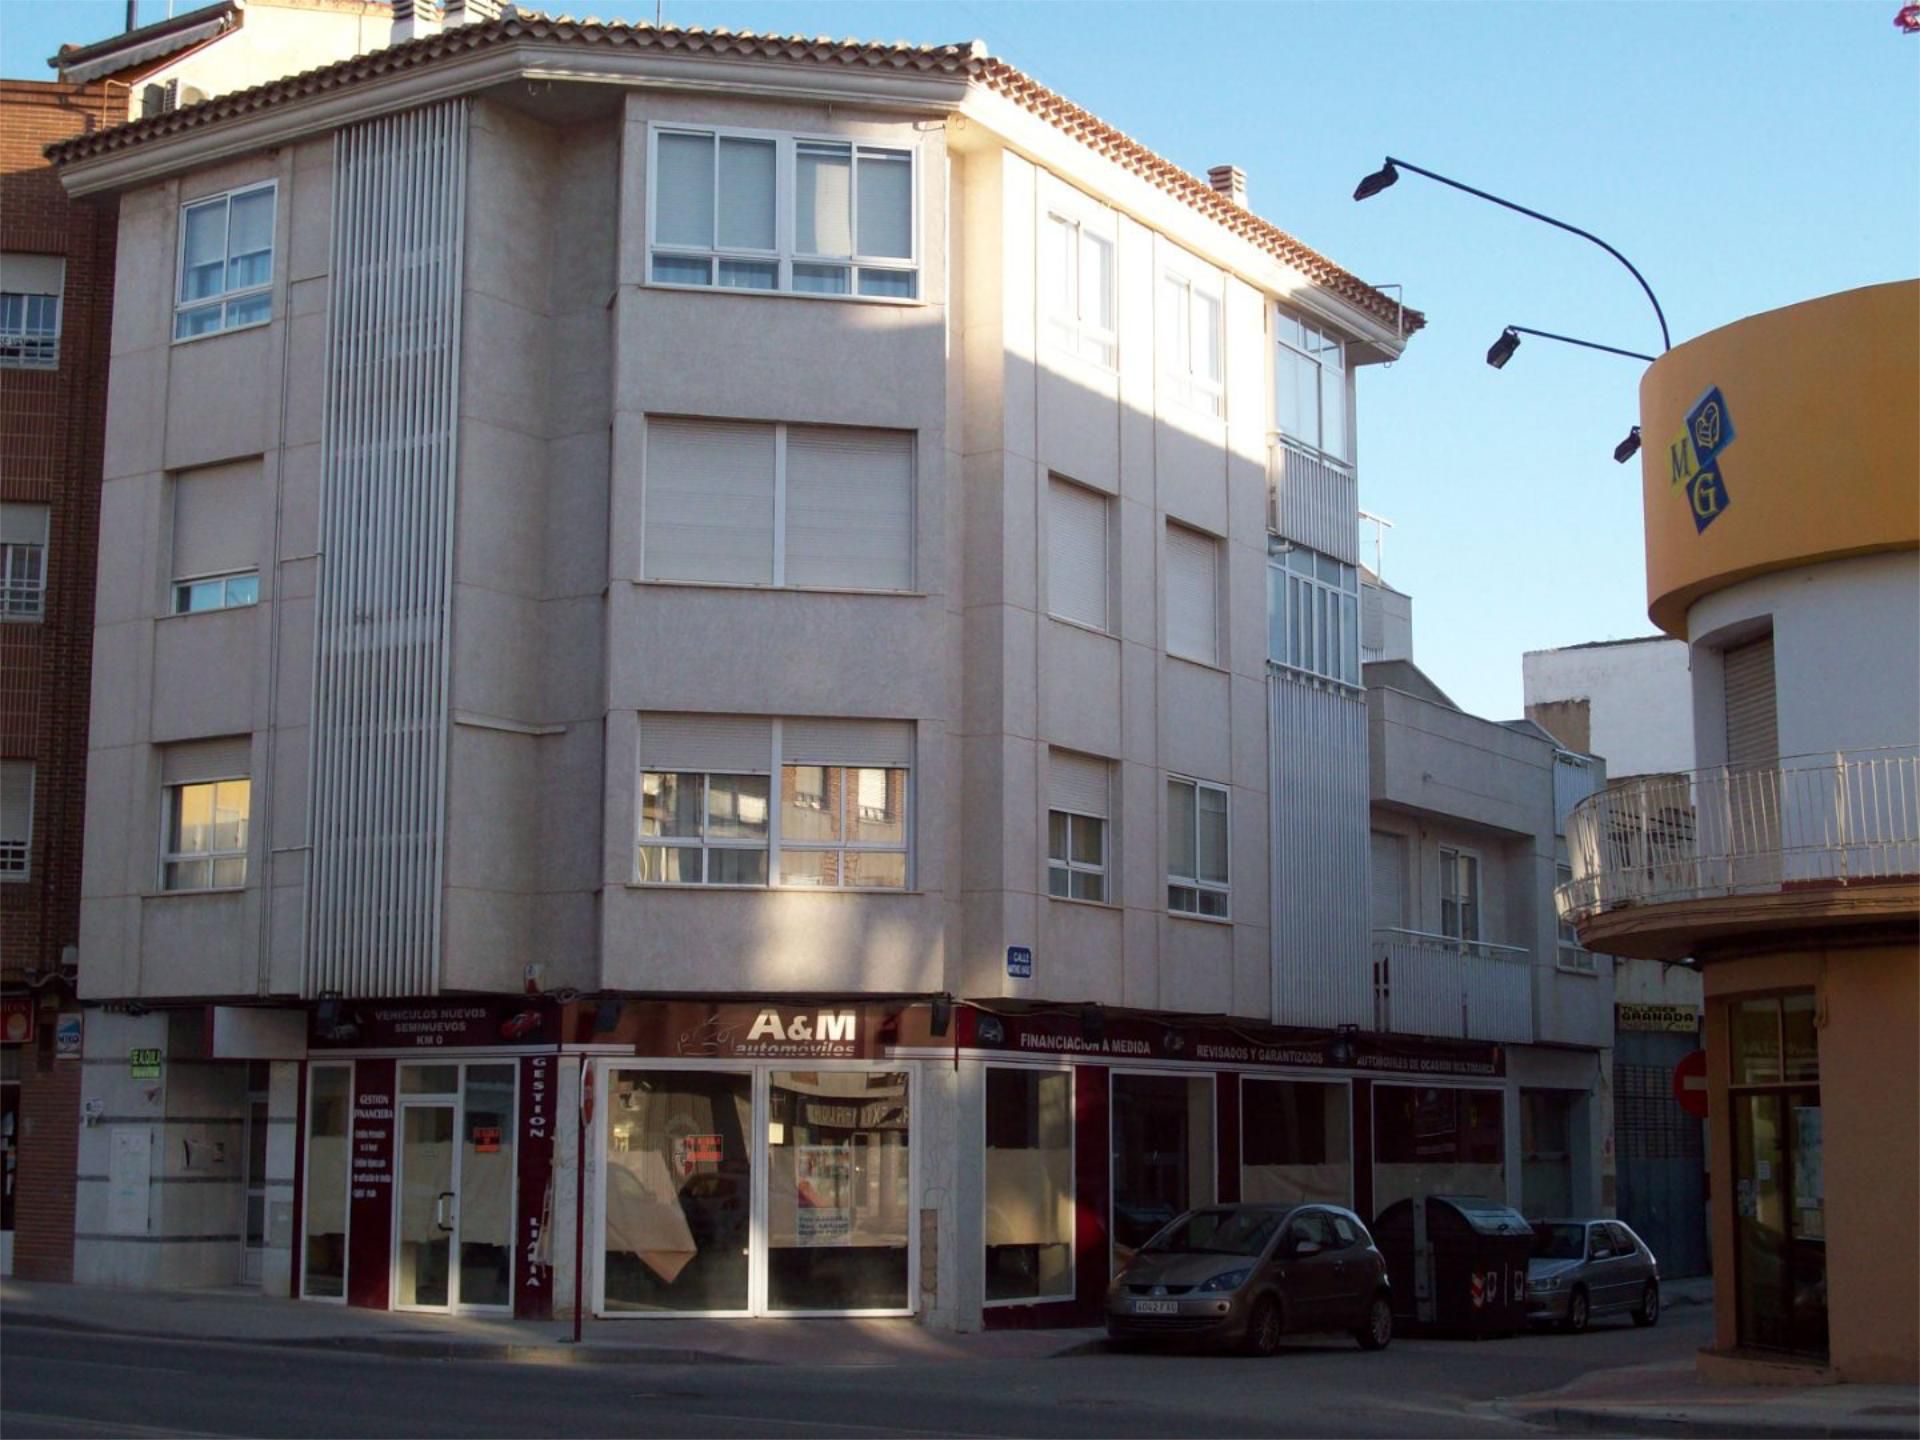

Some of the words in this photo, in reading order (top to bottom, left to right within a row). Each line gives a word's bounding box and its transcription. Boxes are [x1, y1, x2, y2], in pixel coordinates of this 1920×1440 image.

[375, 1009, 439, 1021] VEHICULOS
[440, 1007, 487, 1019] NUEVOS
[1622, 1012, 1694, 1022] GRANADA
[394, 1021, 467, 1033] SEMINUEVOS
[746, 1009, 857, 1041] A&M
[416, 1035, 434, 1046] KM
[1111, 1039, 1152, 1055] MEDIDA
[1196, 1044, 1249, 1061] REVISADOS
[1250, 1049, 1257, 1061] Y
[1258, 1048, 1324, 1064] GARANTIZADOS
